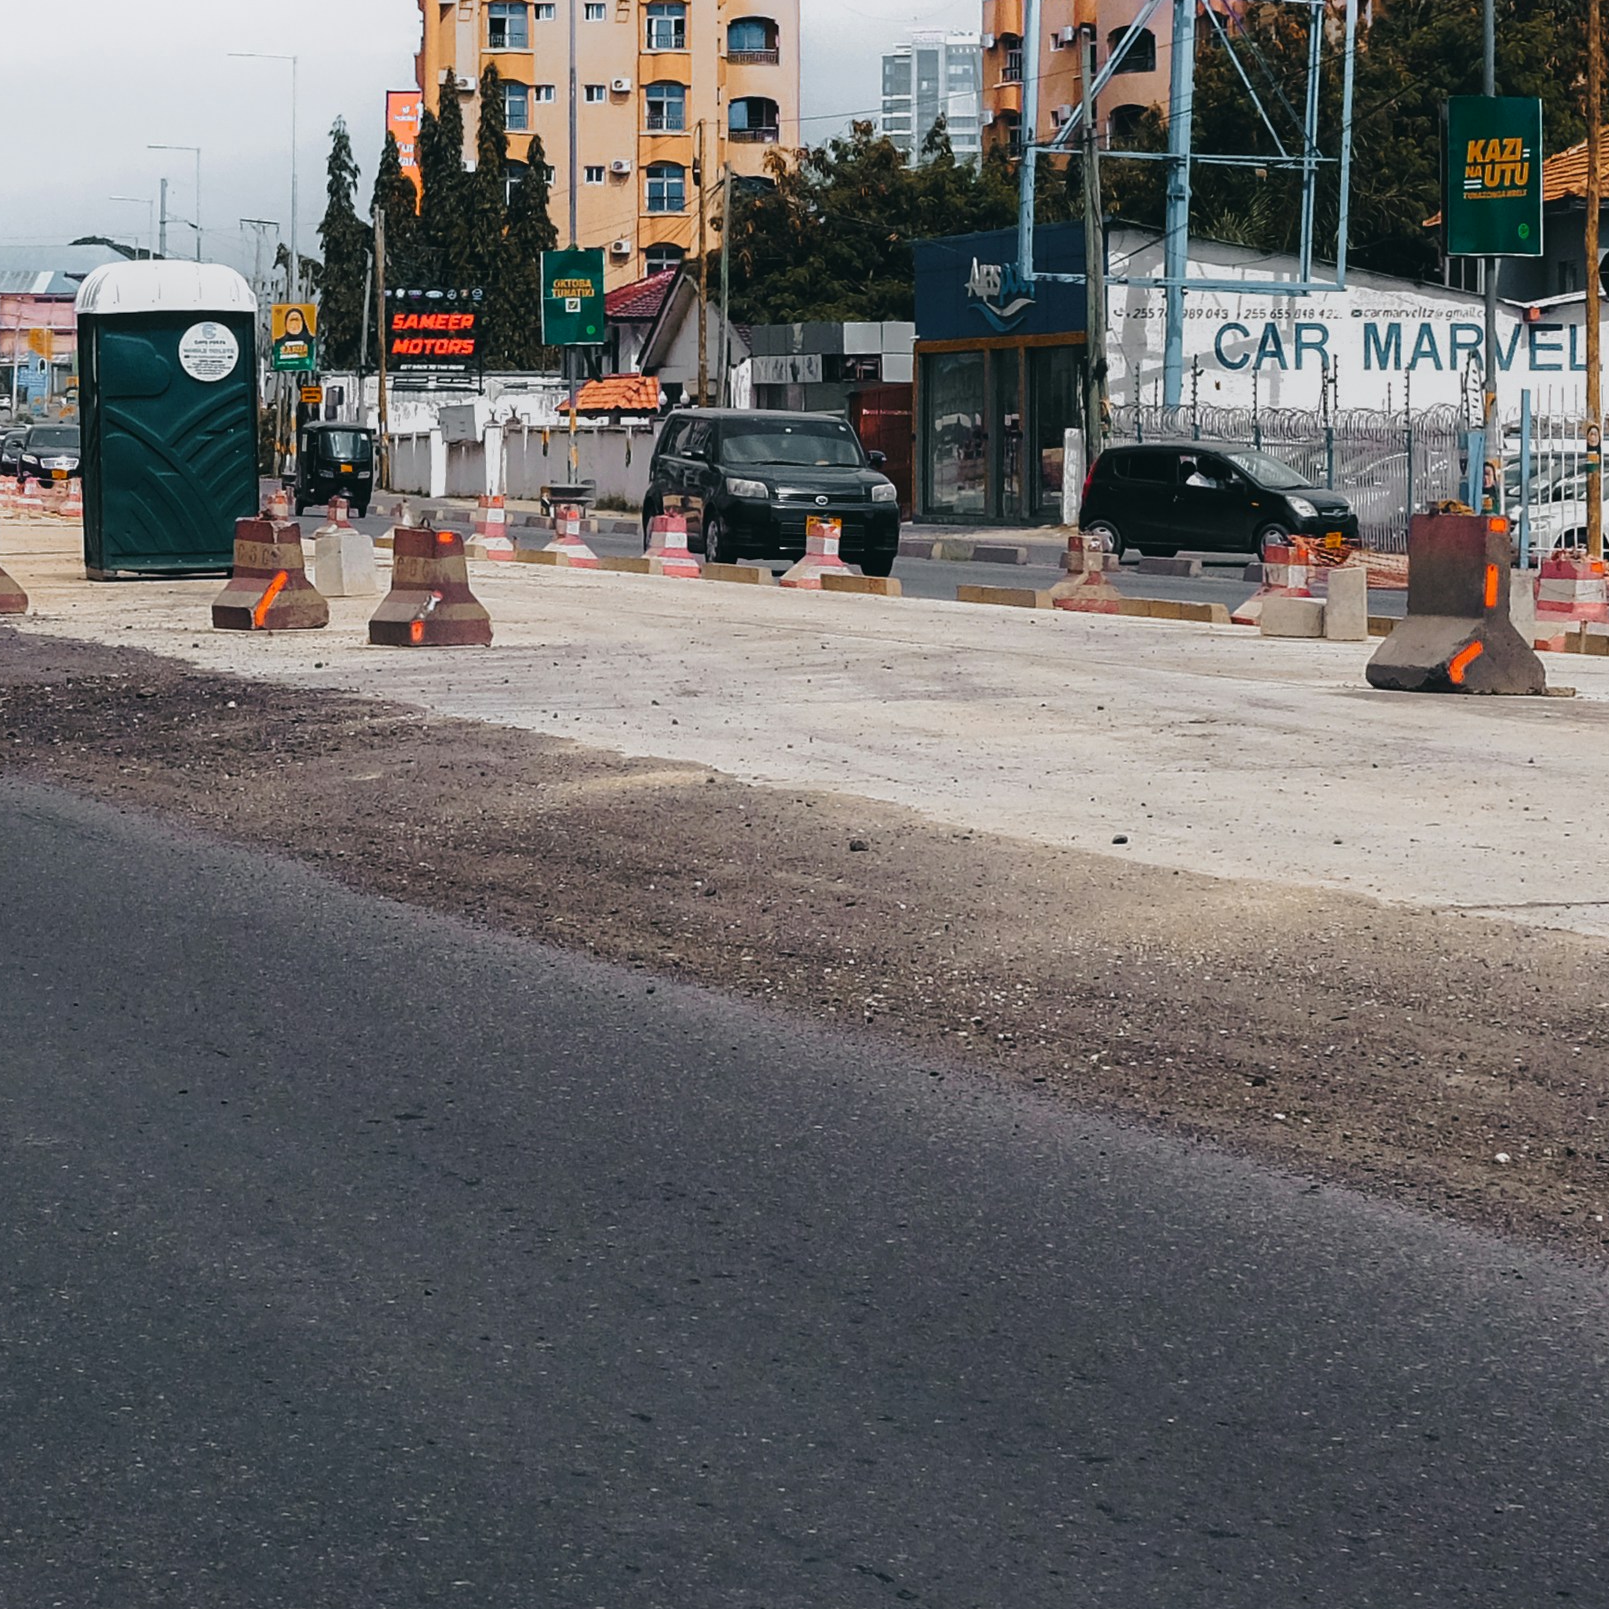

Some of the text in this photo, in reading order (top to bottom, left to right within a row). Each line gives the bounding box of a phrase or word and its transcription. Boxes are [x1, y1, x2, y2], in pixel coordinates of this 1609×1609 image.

[1467, 137, 1523, 163] KAZI
[1465, 162, 1529, 188] NA UTU
[1206, 309, 1229, 319] 043
[1270, 309, 1291, 319] 655
[392, 338, 475, 355] MOTORS
[1214, 322, 1330, 370] CAR
